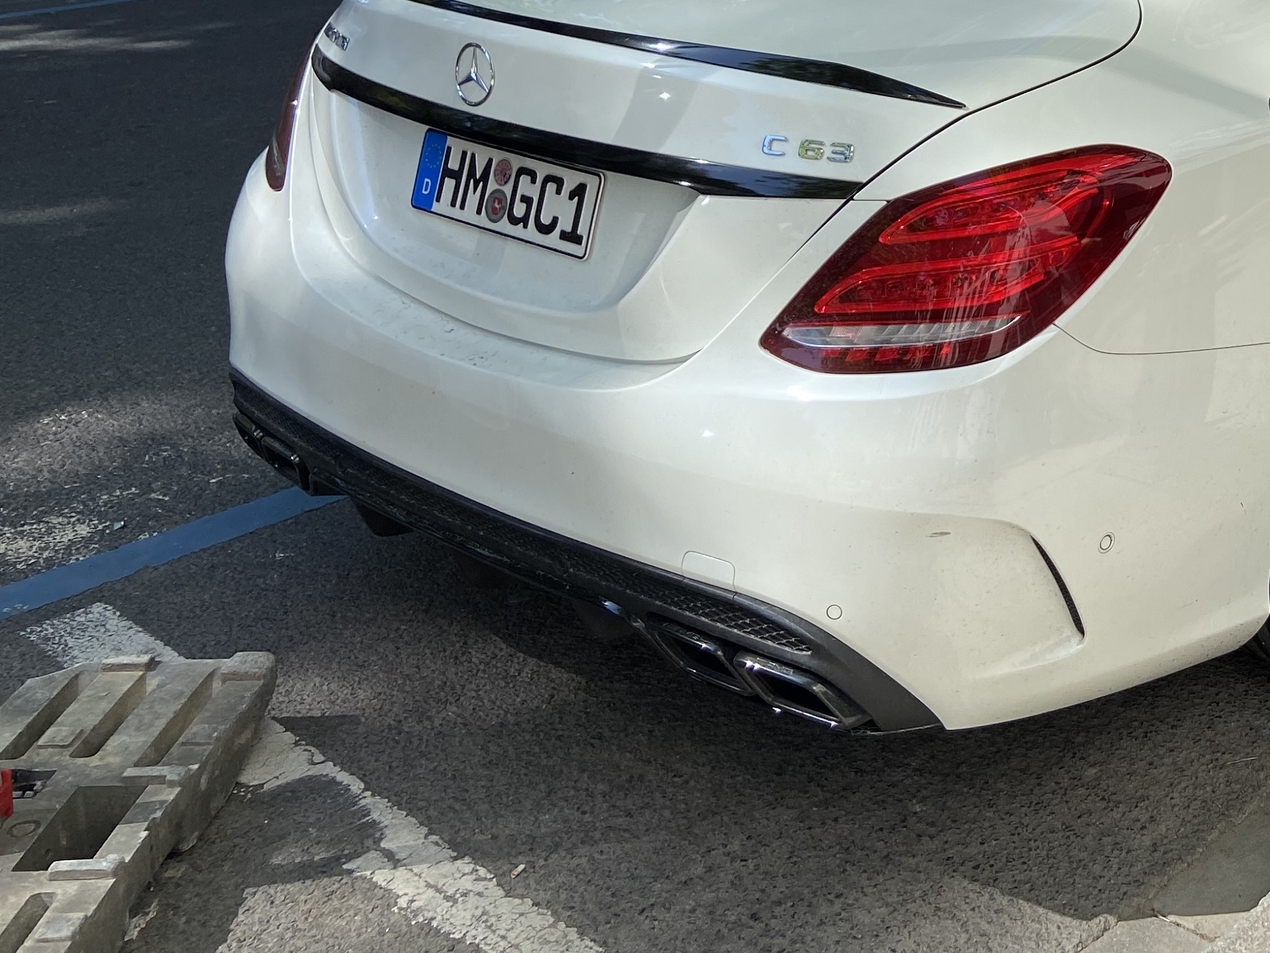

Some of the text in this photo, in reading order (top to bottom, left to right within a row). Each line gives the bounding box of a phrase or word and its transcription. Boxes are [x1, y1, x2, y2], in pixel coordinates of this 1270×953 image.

[761, 134, 856, 164] C 63
[435, 145, 495, 216] HM
